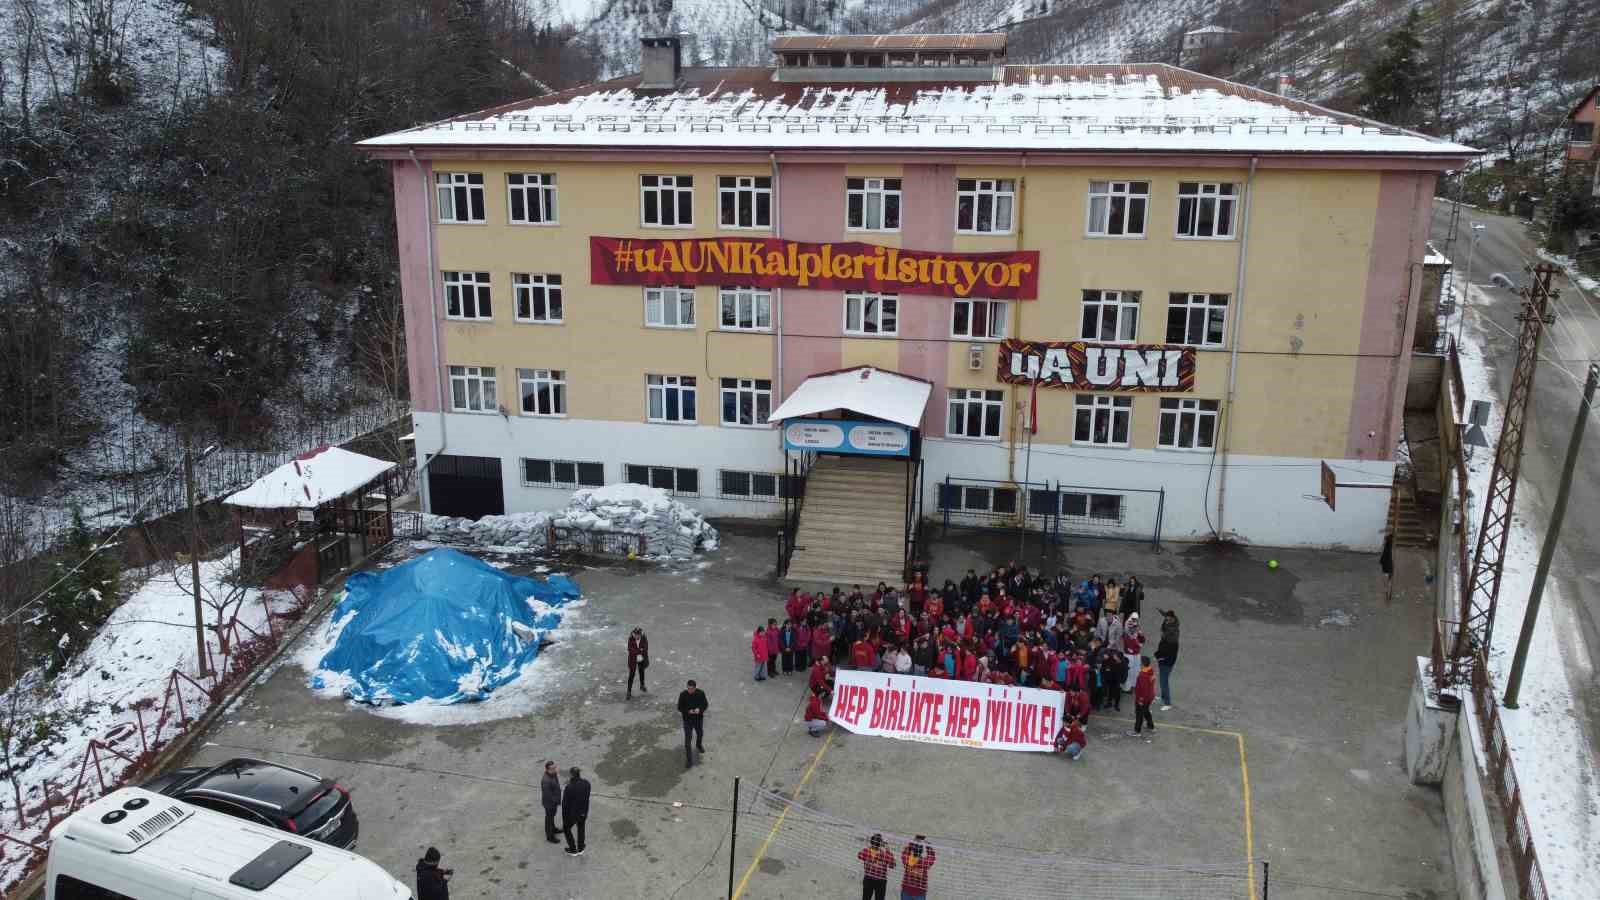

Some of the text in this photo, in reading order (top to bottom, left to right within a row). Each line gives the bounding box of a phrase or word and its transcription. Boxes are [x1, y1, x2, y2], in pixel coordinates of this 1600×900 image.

[1085, 347, 1181, 386] UNI
[834, 677, 1056, 746] HEP BİRLİKTE HEP İYİLİKLE!
